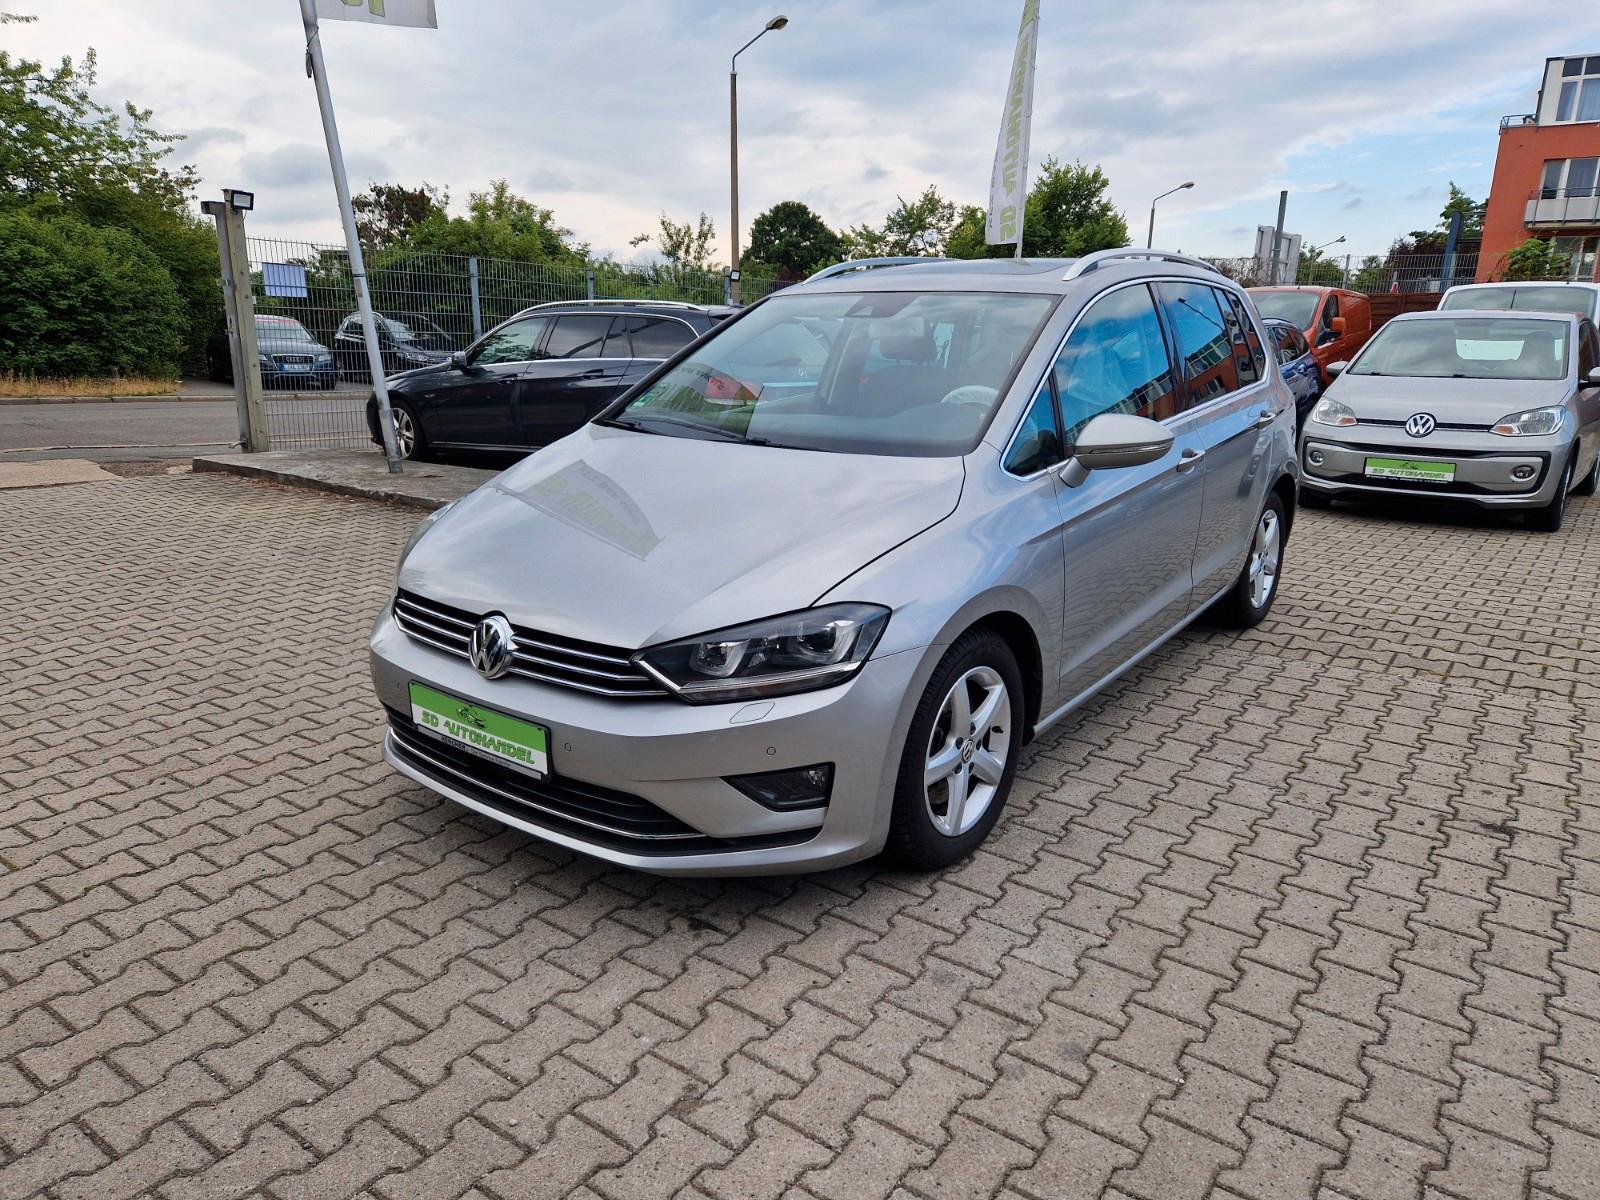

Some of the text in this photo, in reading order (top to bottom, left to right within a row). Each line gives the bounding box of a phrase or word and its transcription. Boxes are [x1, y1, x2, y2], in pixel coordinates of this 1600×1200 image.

[1405, 413, 1436, 437] VW
[1388, 469, 1447, 479] AUTOHANDEL
[470, 617, 508, 678] VW
[421, 710, 439, 728] SD
[443, 720, 535, 765] AUTOHANDEL
